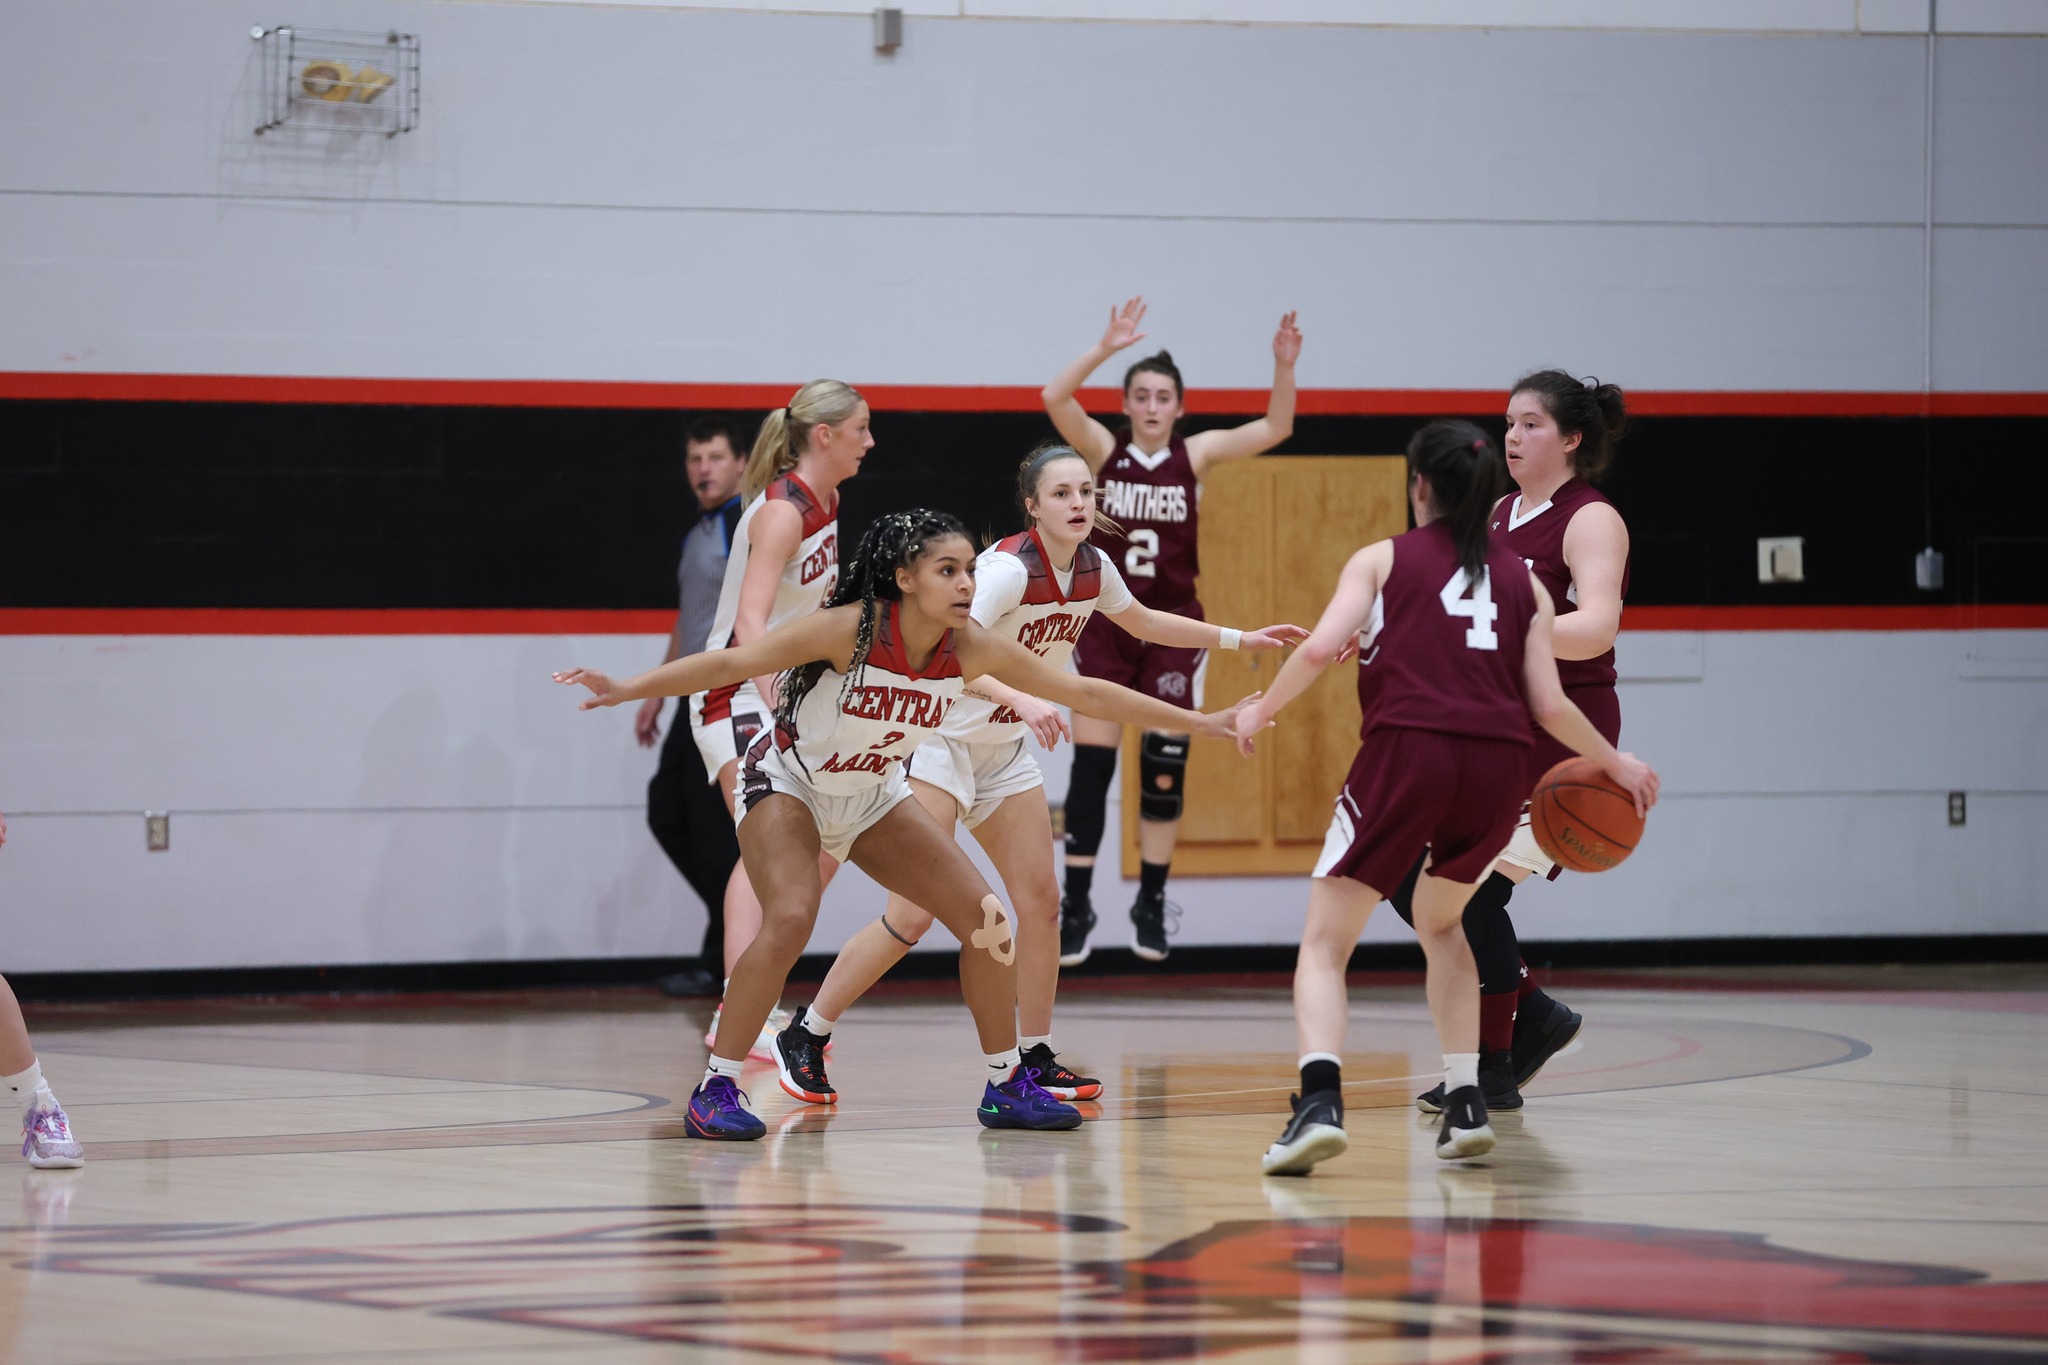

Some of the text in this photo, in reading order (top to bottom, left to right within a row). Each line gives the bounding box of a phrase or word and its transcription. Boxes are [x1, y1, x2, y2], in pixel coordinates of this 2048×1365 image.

[1103, 479, 1188, 523] PANTHERS
[1125, 529, 1160, 578] 2
[1439, 564, 1498, 651] 4
